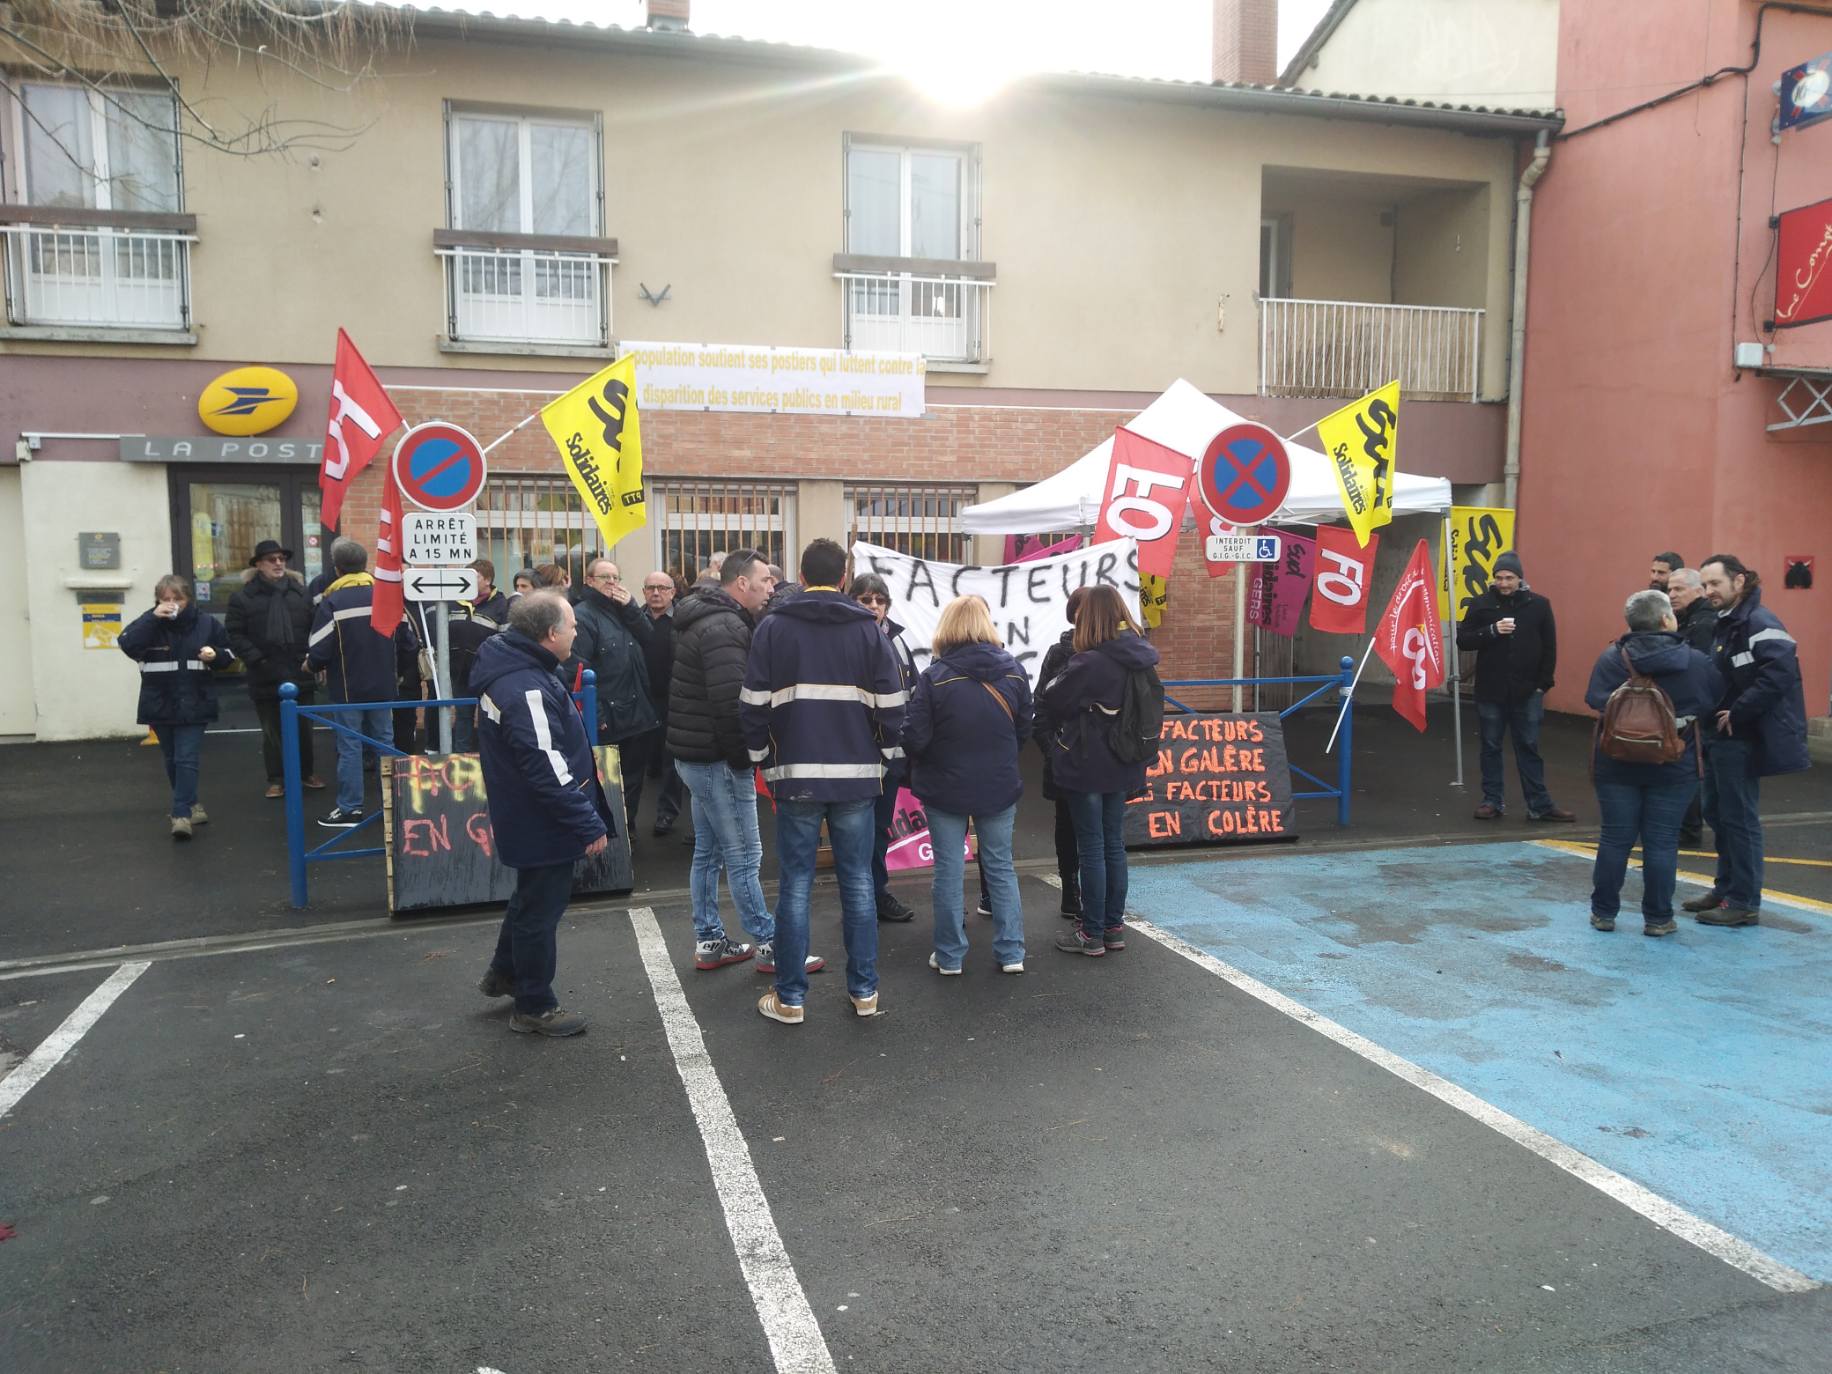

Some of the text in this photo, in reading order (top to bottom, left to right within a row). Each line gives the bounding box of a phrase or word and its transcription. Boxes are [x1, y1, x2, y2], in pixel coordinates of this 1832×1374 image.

[634, 347, 695, 370] population
[699, 348, 745, 369] soutient
[748, 353, 769, 369] ses
[771, 351, 817, 374] postiers
[819, 352, 837, 376] qui
[839, 353, 875, 374] luttent
[878, 356, 913, 375] contre
[642, 383, 902, 411] disparition des services publics en milieu rural
[144, 441, 323, 459] LA POST
[565, 431, 613, 516] Solidaires
[1333, 442, 1366, 515] Solidaires
[415, 518, 465, 530] ARRÊT
[414, 532, 467, 545] LIMITÉ
[409, 549, 472, 559] A 15 MN
[868, 548, 1139, 608] FACTEURS
[1318, 548, 1364, 606] FO
[1250, 577, 1263, 620] GERS
[1159, 719, 1264, 743] FACTEURS
[1166, 780, 1272, 803] FACTEURS
[403, 814, 452, 857] EN
[1148, 811, 1181, 838] EN
